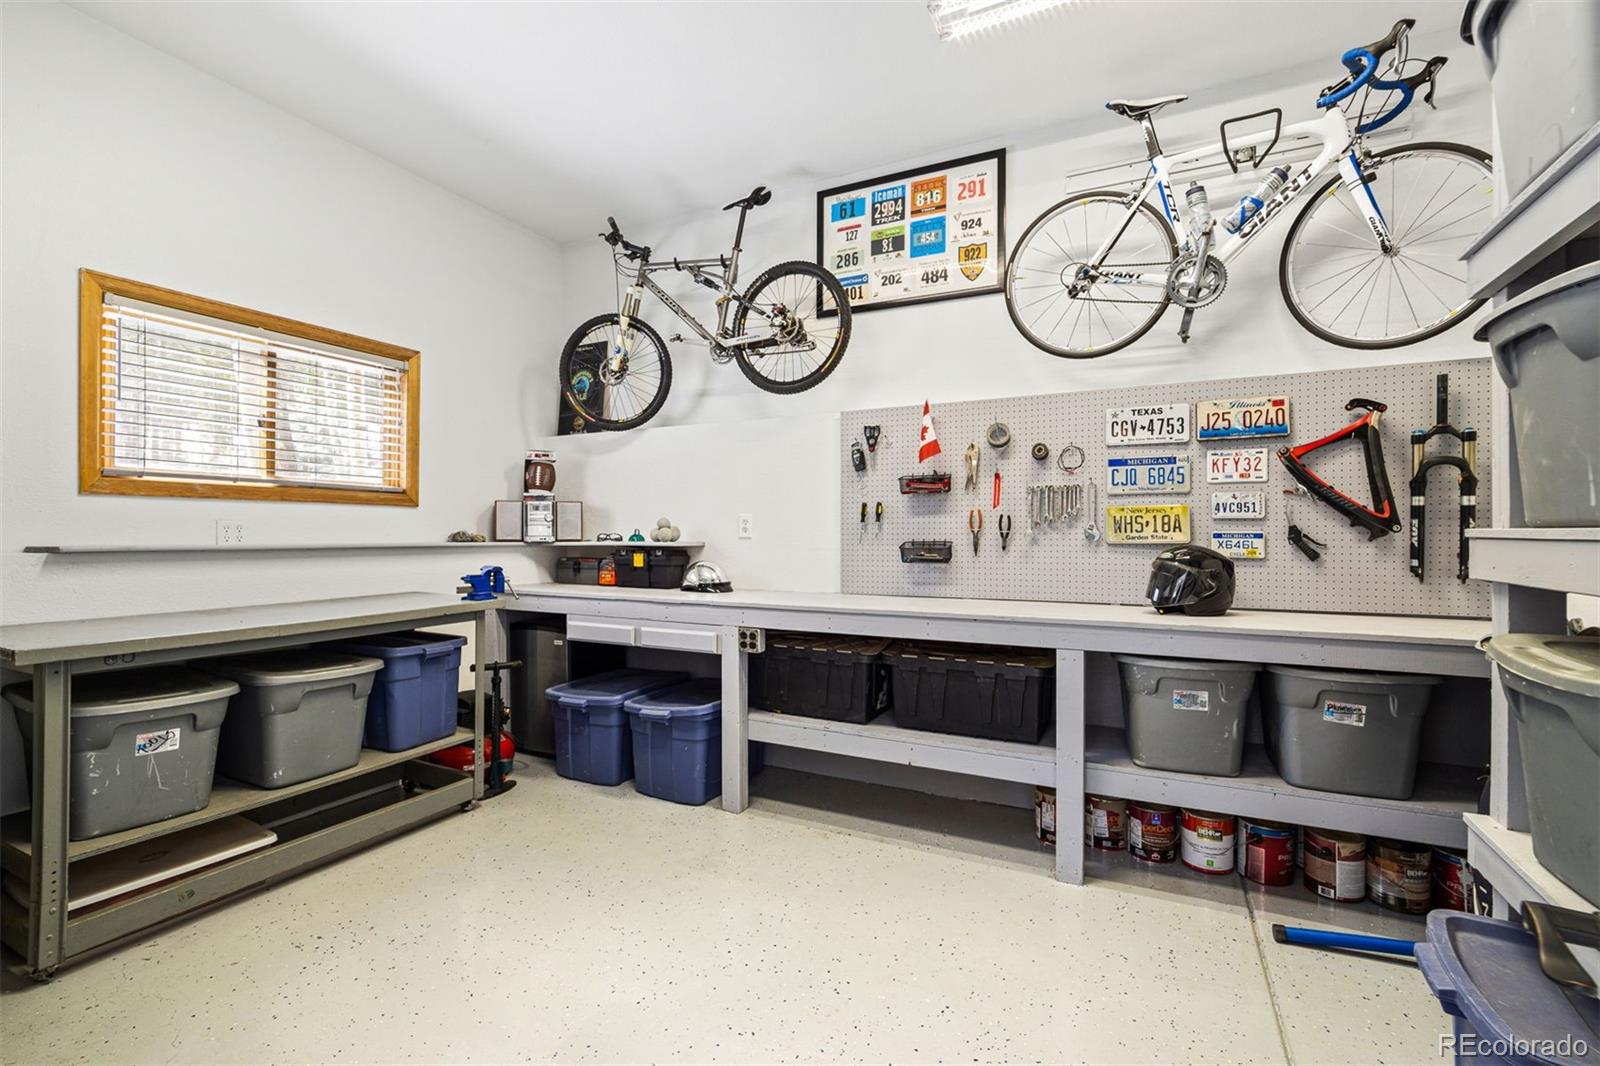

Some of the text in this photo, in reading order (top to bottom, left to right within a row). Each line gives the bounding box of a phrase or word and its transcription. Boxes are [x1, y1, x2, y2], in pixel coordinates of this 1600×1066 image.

[957, 178, 986, 201] 291
[916, 189, 941, 207] 816
[1164, 181, 1180, 222] TCR
[1239, 163, 1313, 239] GIANT
[840, 201, 856, 219] 61
[874, 198, 903, 219] 2994
[875, 215, 901, 224] TREK
[961, 218, 982, 230] 924
[845, 230, 859, 241] 127
[882, 237, 894, 253] 81
[836, 251, 859, 269] 286
[964, 247, 982, 262] 922
[881, 273, 902, 286] 202
[921, 268, 949, 284] 484
[1131, 407, 1163, 416] TEXAS
[1229, 400, 1266, 409] Illinois
[1201, 408, 1285, 431] J25 0240
[1148, 466, 1185, 485] 6845
[1214, 502, 1257, 513] 4VC951
[1217, 540, 1259, 550] X646L
